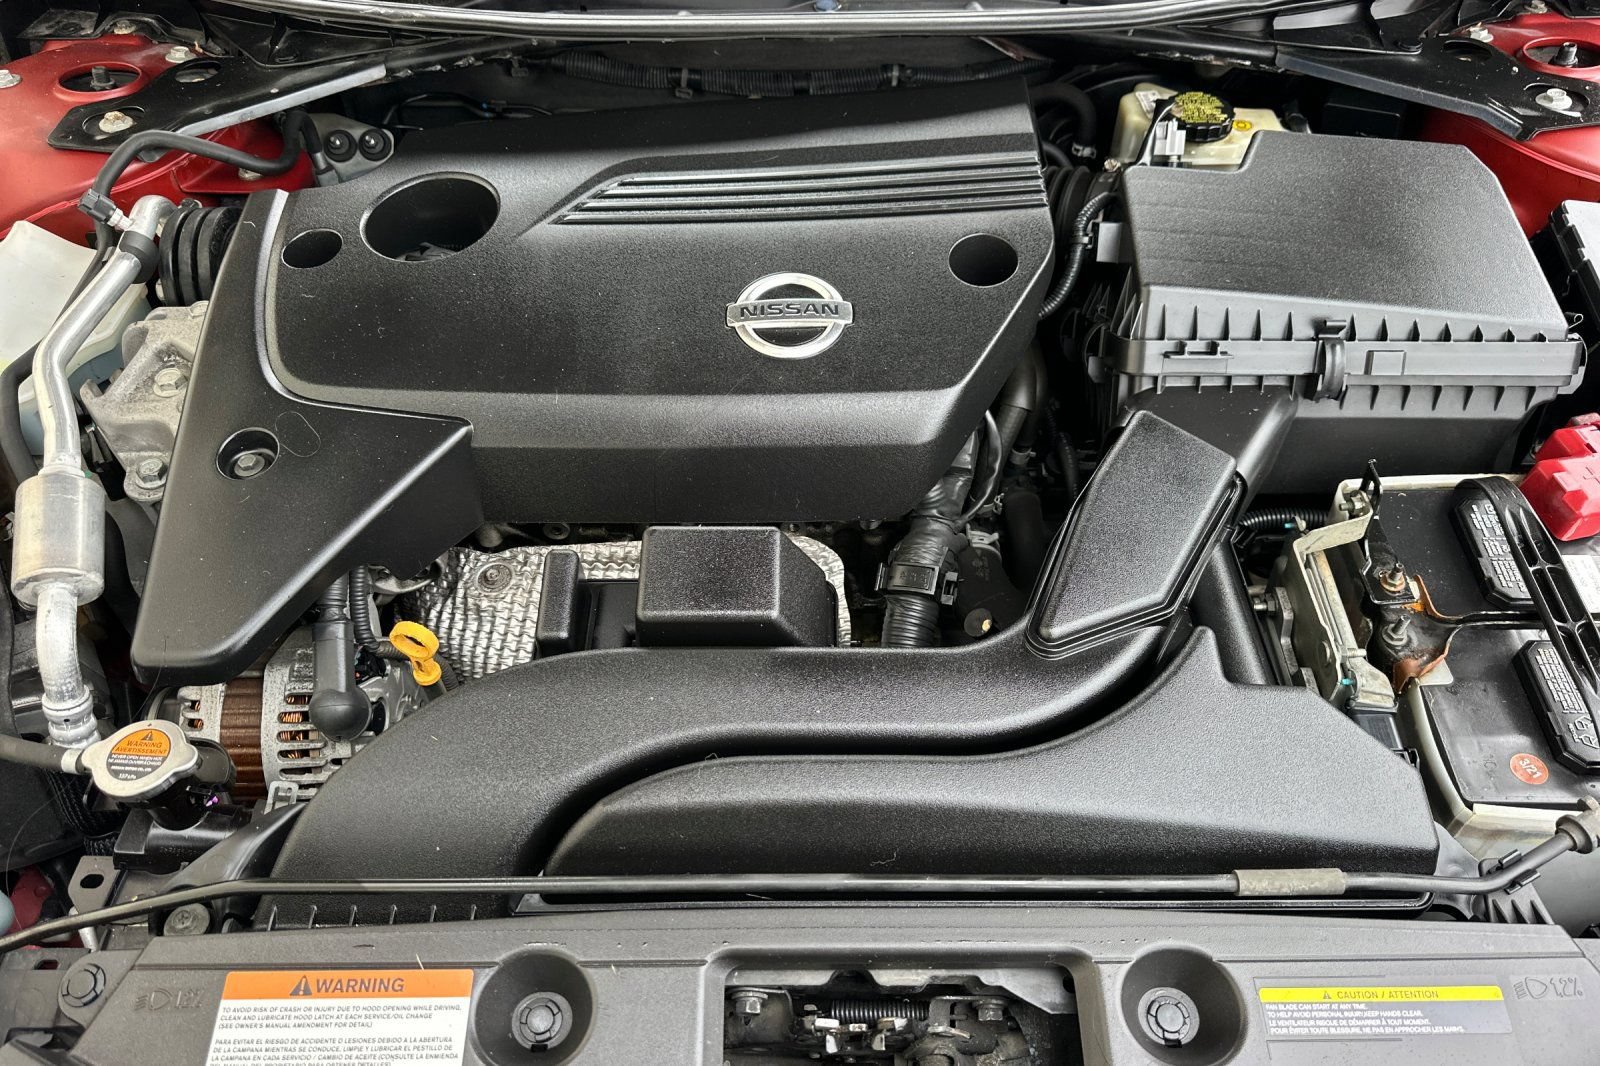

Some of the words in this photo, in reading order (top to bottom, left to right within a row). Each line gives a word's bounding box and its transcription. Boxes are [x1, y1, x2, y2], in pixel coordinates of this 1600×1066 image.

[740, 303, 839, 318] NISSAN
[115, 746, 168, 754] AVERTISSEMENT
[127, 740, 162, 748] WARNING
[1519, 758, 1542, 778] 3/21
[316, 978, 405, 994] WARNING
[1336, 991, 1379, 999] CAUTION
[1388, 990, 1439, 999] ATTENTION
